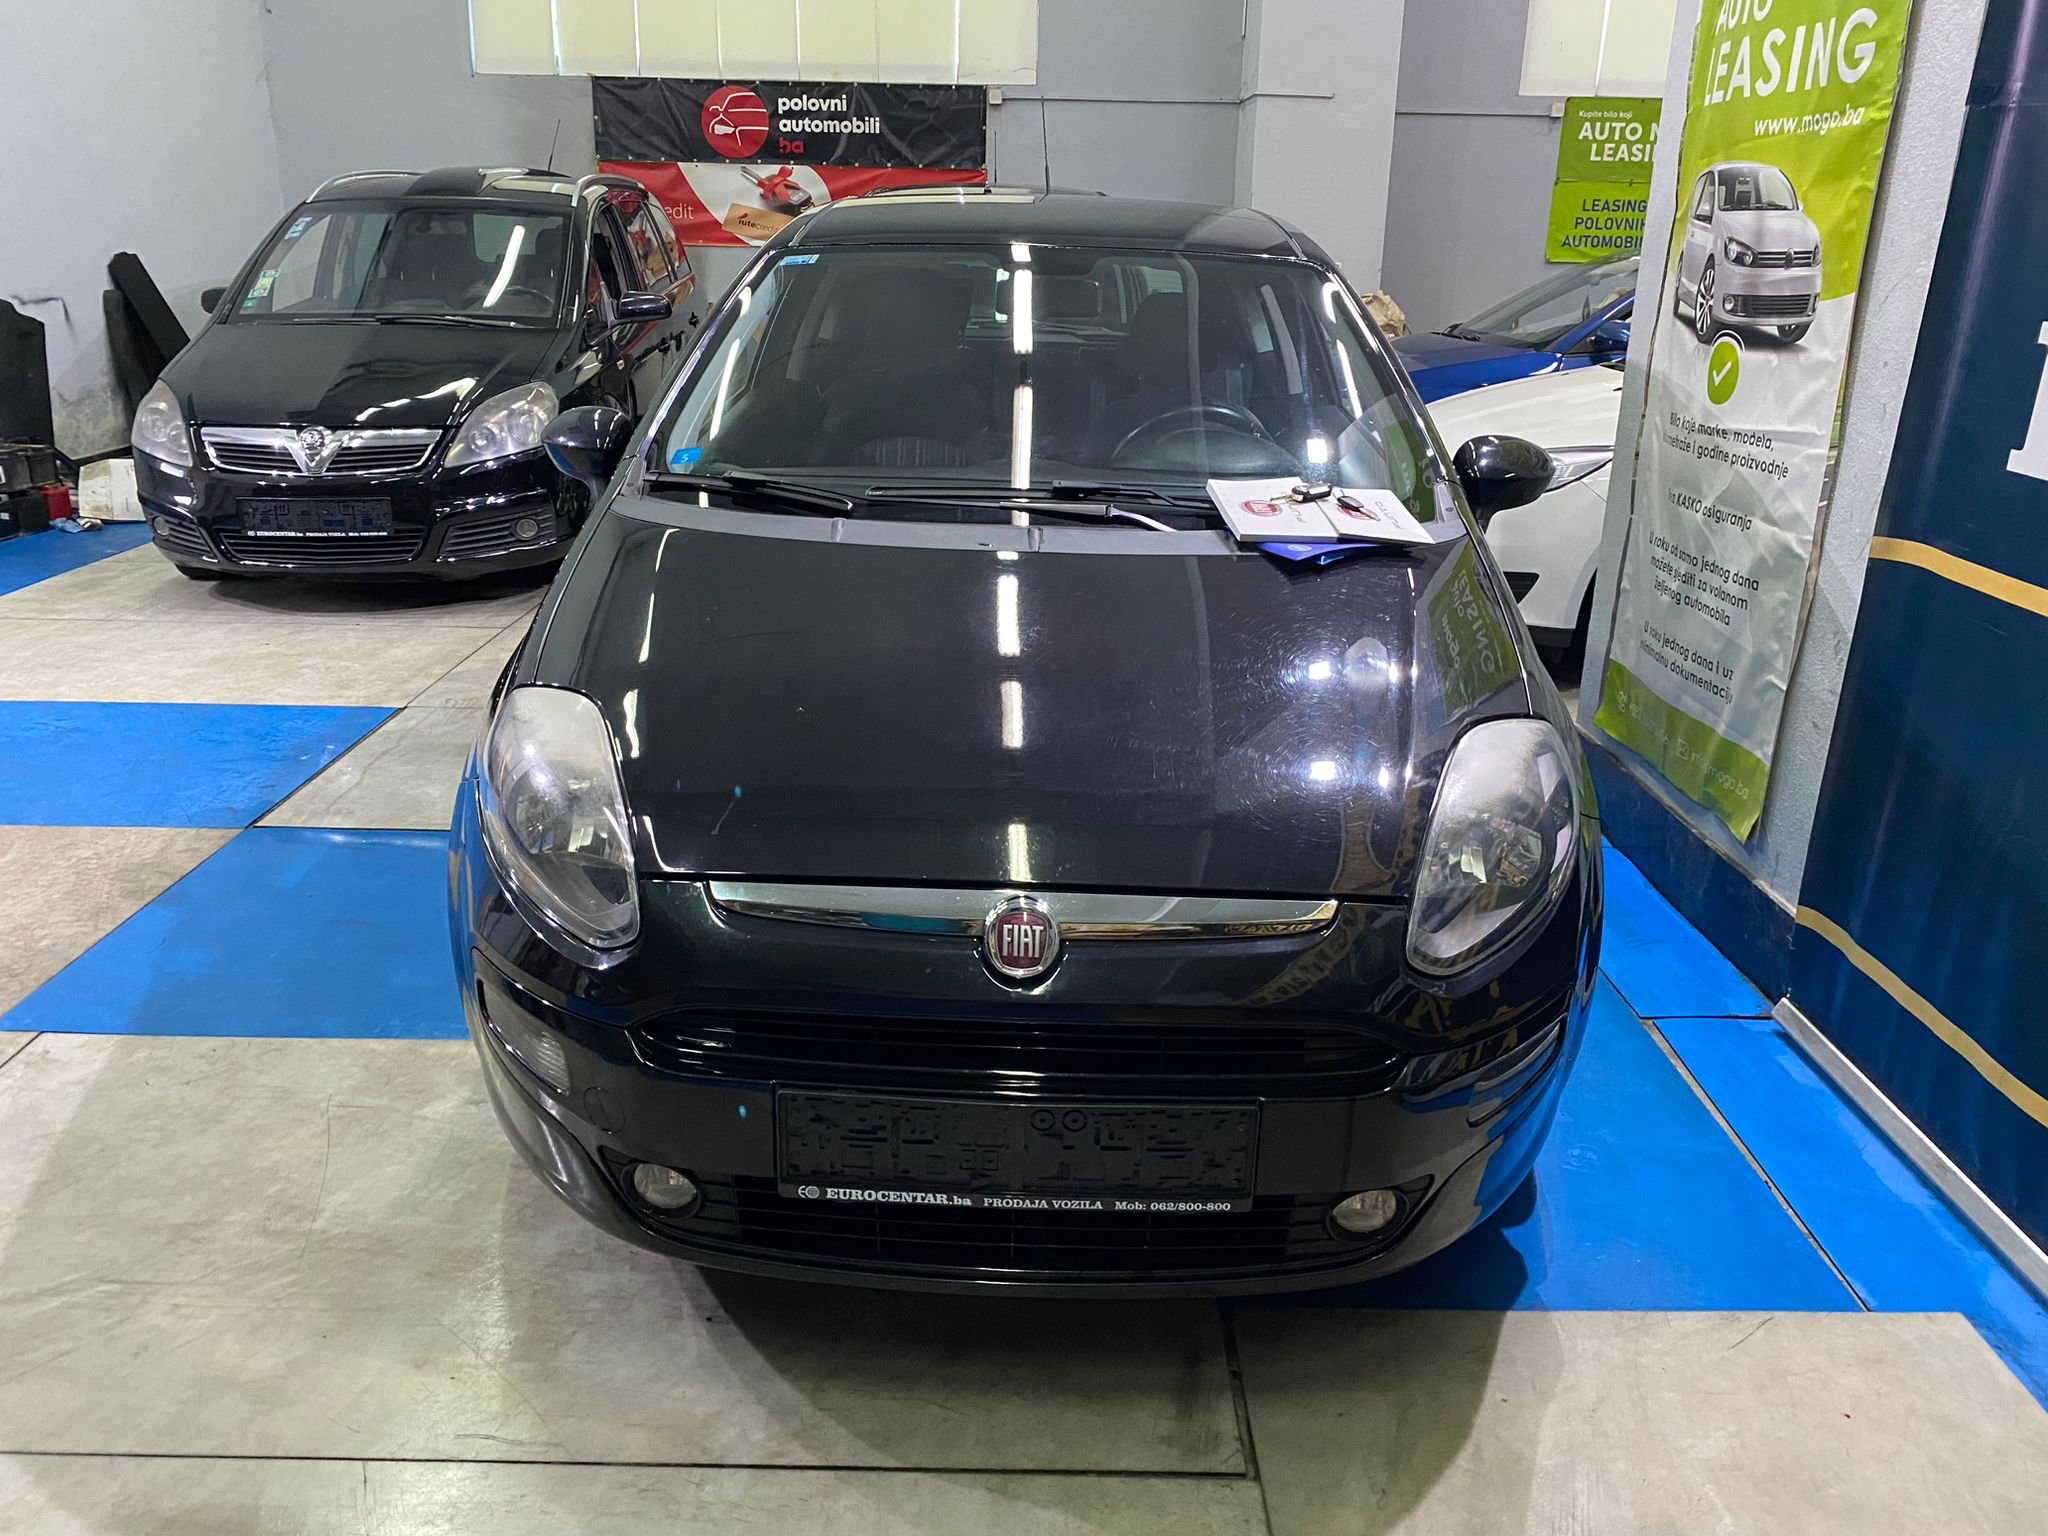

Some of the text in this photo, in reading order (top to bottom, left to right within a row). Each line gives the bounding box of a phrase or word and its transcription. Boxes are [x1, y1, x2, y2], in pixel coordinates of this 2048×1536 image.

[1703, 7, 1878, 107] LEASING
[777, 94, 848, 114] polovni
[1578, 110, 1633, 120] Kupite bilo koji
[1754, 103, 1865, 136] www.mogo.ba
[778, 117, 880, 134] automobili
[1577, 122, 1643, 141] AUTO
[1589, 143, 1655, 162] LEASI
[1582, 199, 1648, 213] LEASING
[1681, 416, 1697, 435] koje
[1697, 423, 1731, 441] marke,
[1733, 429, 1774, 452] modela,
[1697, 443, 1730, 461] godine
[1730, 453, 1789, 480] proizvodnje
[1676, 493, 1703, 514] KASKO
[1702, 504, 1753, 533] osiguranja
[1649, 531, 1655, 545] U
[1653, 536, 1670, 553] roku
[1678, 548, 1699, 567] samo
[1700, 555, 1731, 584] jednog
[1732, 569, 1760, 592] dana
[1650, 556, 1749, 611] možete sjediti za volanom
[1684, 594, 1731, 627] automobila
[1661, 633, 1690, 662] jednog
[1691, 650, 1714, 672] dana
[1715, 660, 1720, 675] i
[1722, 666, 1734, 681] uz
[1670, 660, 1734, 705] dokumentaciju
[1001, 924, 1044, 958] FIAT
[825, 1187, 1232, 1212] EUROCENTAR.ba PRODAJA VOZILA Mob: 062/800-800
